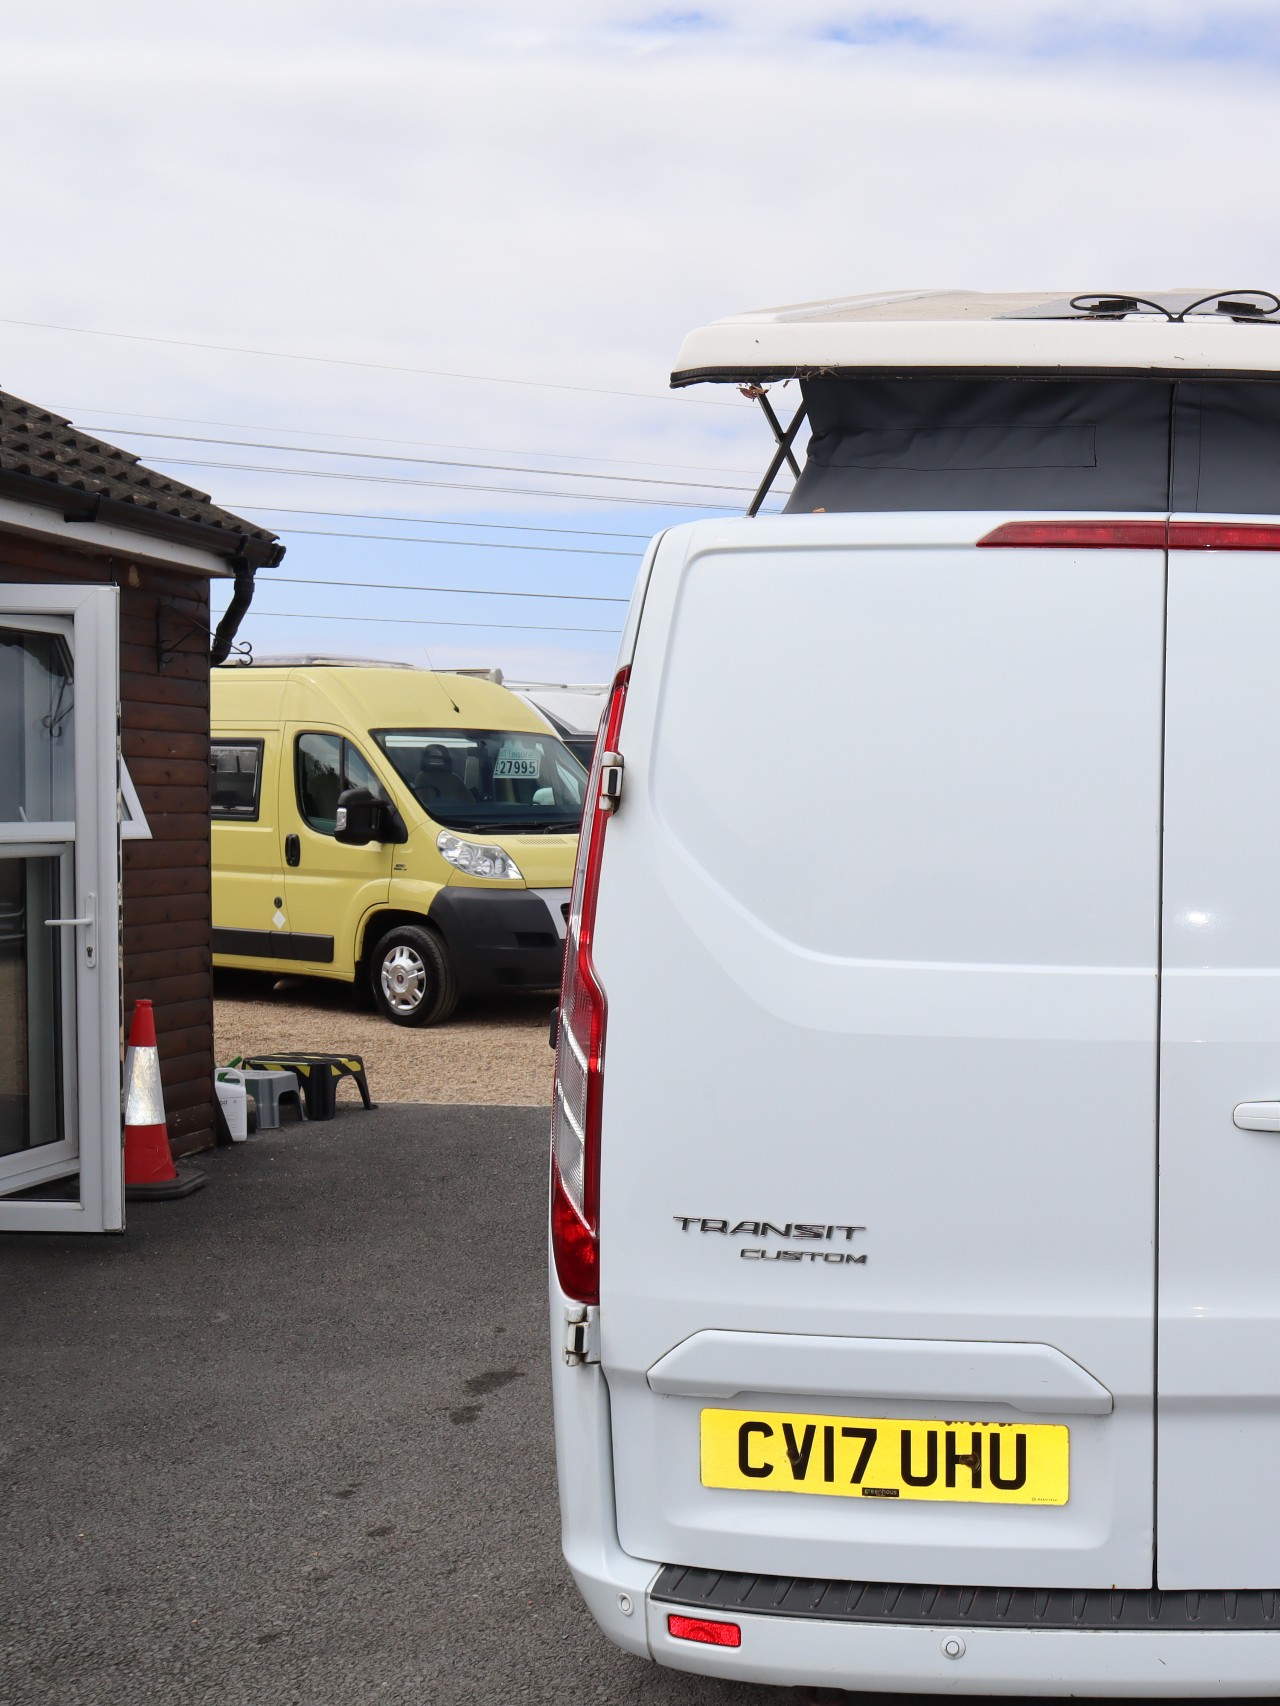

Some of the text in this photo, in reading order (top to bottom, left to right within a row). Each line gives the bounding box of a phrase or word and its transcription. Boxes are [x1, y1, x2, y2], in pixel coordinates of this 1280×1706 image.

[673, 1216, 866, 1241] TRANSIT
[740, 1248, 868, 1265] CUSTOM
[738, 1421, 1027, 1490] CV17 UHU
